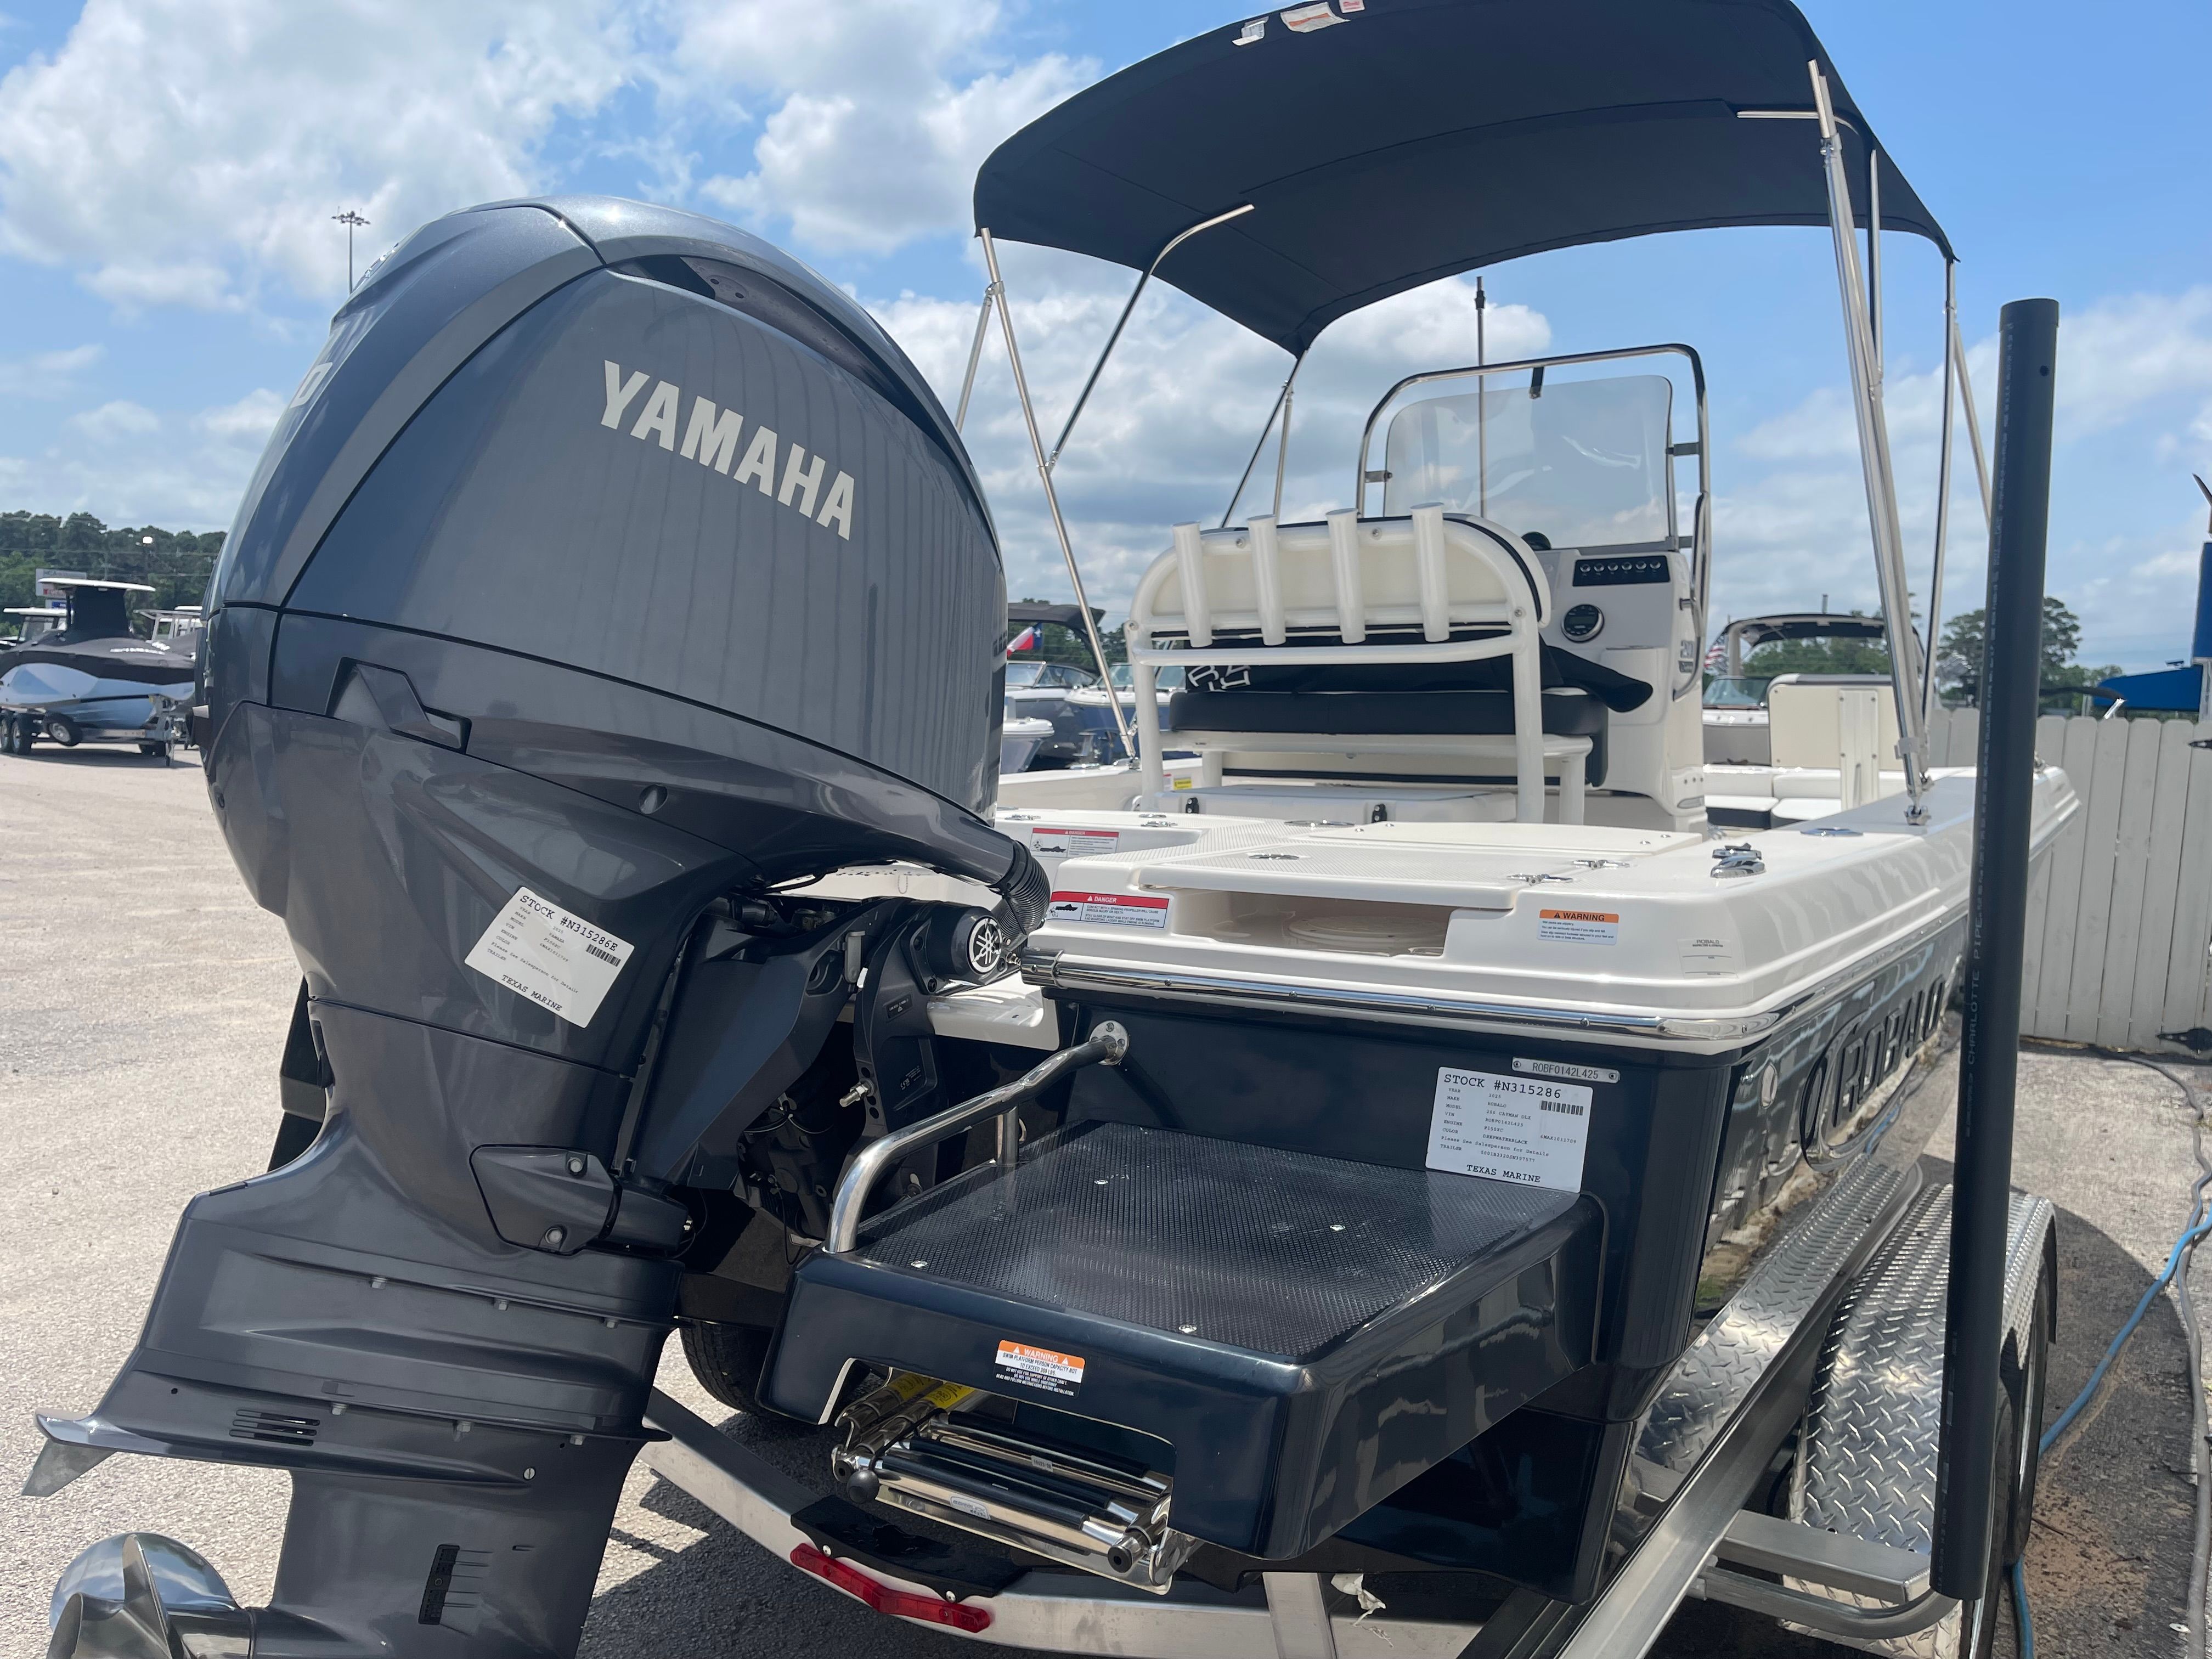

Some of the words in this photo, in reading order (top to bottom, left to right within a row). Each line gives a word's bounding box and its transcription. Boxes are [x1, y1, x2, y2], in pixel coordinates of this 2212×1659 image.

[601, 360, 854, 541] YAMAHA
[520, 895, 555, 919] STOCK
[560, 916, 618, 951] #N315286E
[1563, 912, 1605, 922] WARNING
[1973, 916, 1983, 960] PIPE
[501, 974, 528, 992] TEXAS
[531, 991, 562, 1012] MARINE
[1967, 969, 1981, 1065] CHARLOTTE
[1831, 974, 1946, 1128] ROBALO
[1444, 1074, 1485, 1088] STOCK
[1494, 1080, 1561, 1098] #N315286
[1475, 1141, 1510, 1150] Salesperson
[1540, 1134, 1576, 1144] 6MAX1011709
[1466, 1164, 1497, 1176] TEXAS
[1503, 1170, 1541, 1183] MARINE
[1014, 1355, 1034, 1364] PLATFORM
[1035, 1359, 1050, 1368] PERSON
[1050, 1363, 1069, 1372] CAPACITY
[1024, 1347, 1058, 1363] WARNING
